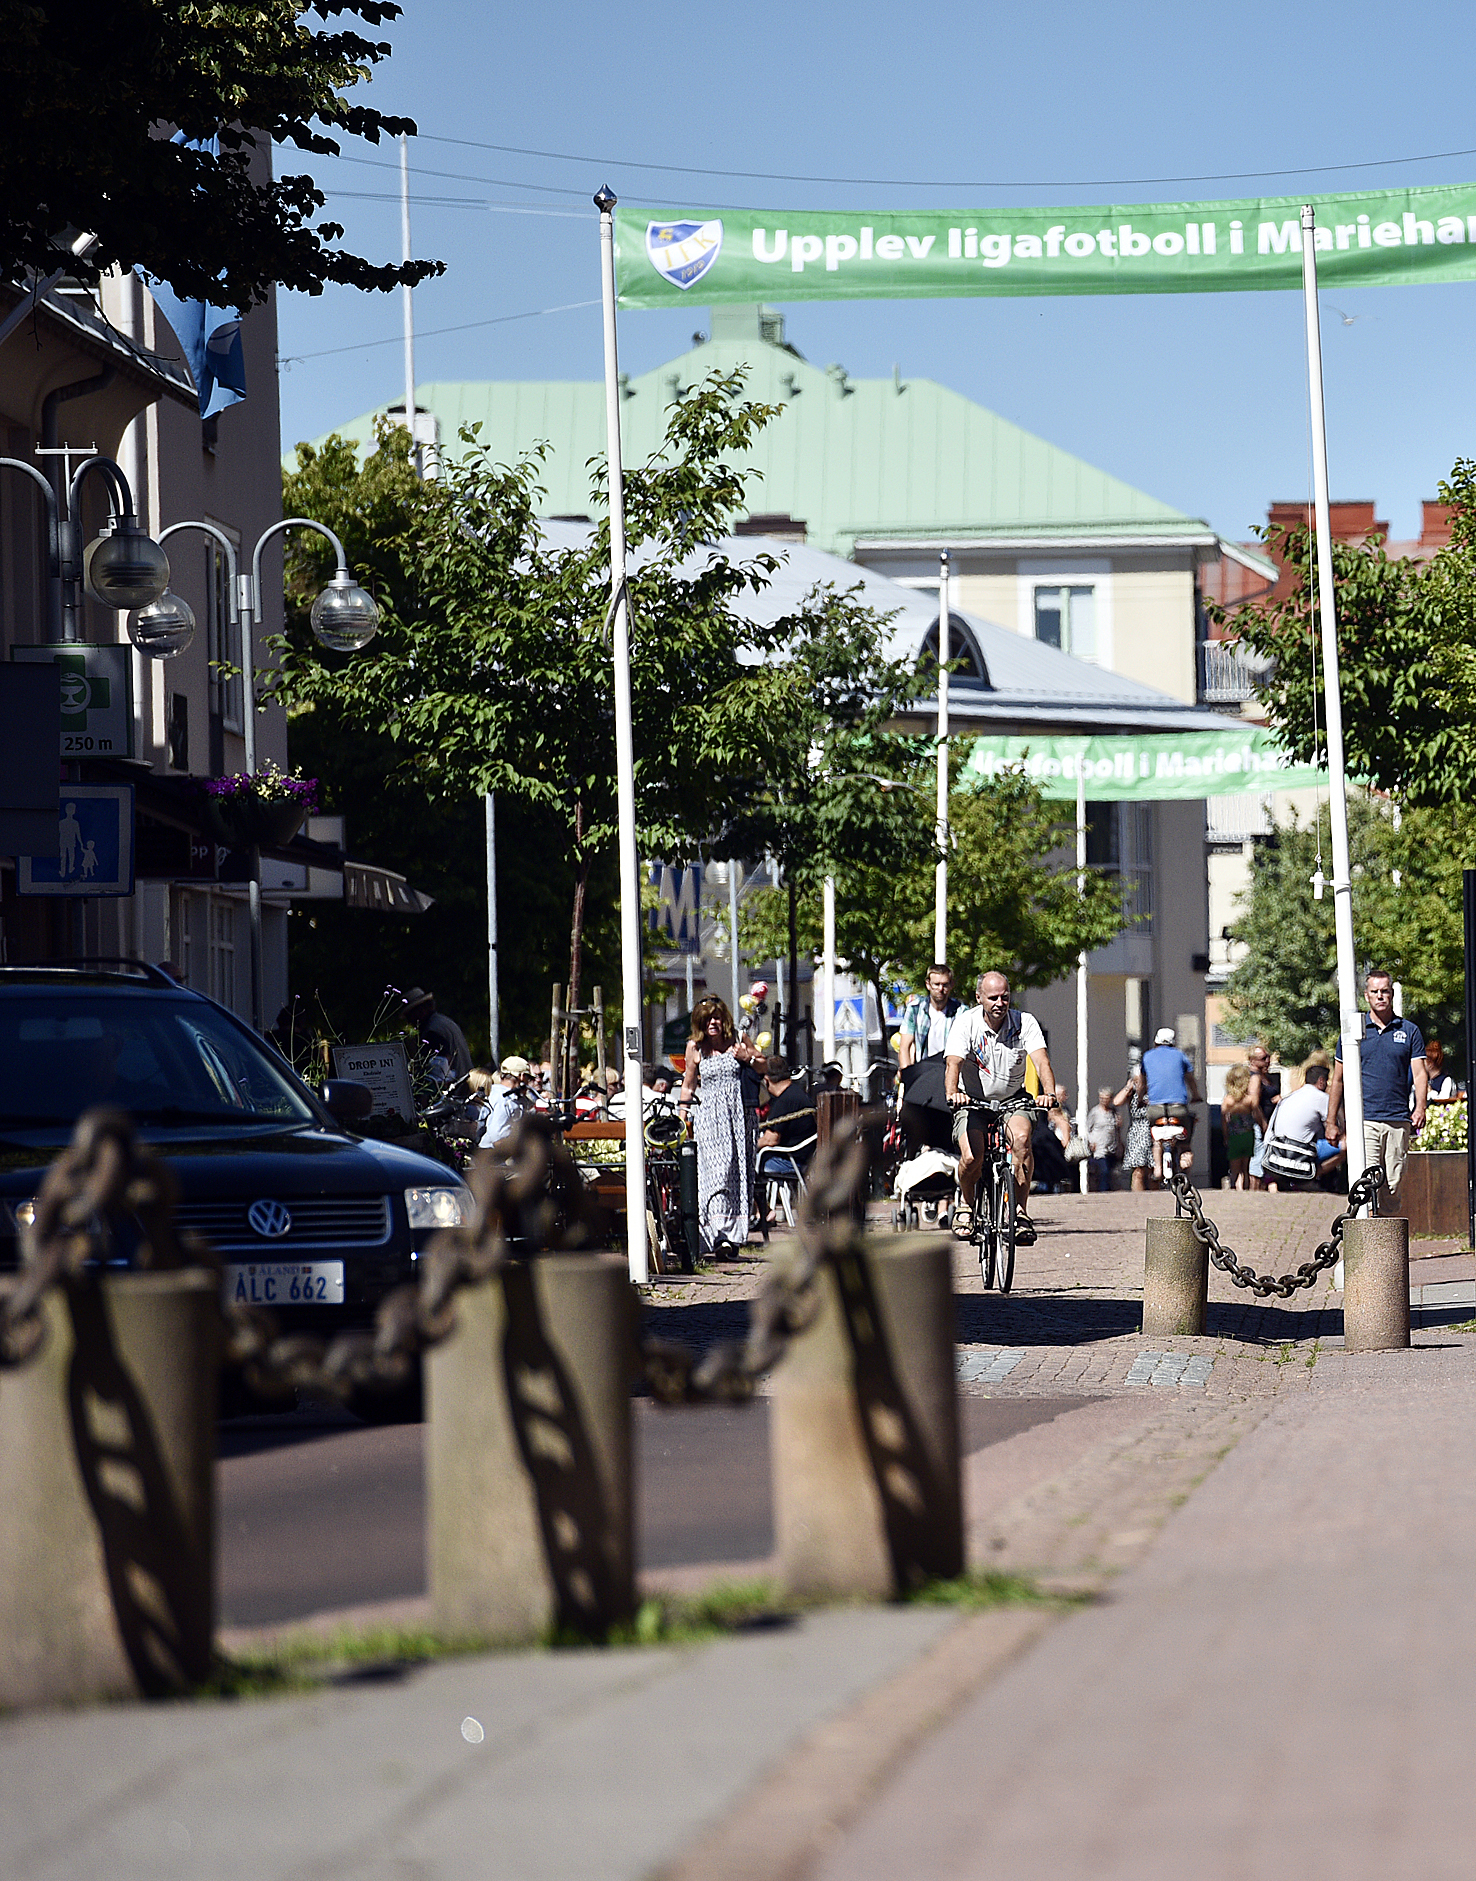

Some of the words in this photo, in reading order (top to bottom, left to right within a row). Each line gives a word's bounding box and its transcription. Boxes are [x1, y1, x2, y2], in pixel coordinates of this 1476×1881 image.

[752, 226, 936, 272] Upplev
[948, 222, 1217, 268] ligafotboll
[1229, 220, 1244, 255] i
[64, 736, 94, 751] 250
[99, 739, 113, 750] m
[348, 1059, 377, 1071] DROP
[380, 1058, 394, 1069] IN!
[236, 1272, 277, 1303] ÅLC
[290, 1276, 327, 1301] 662
